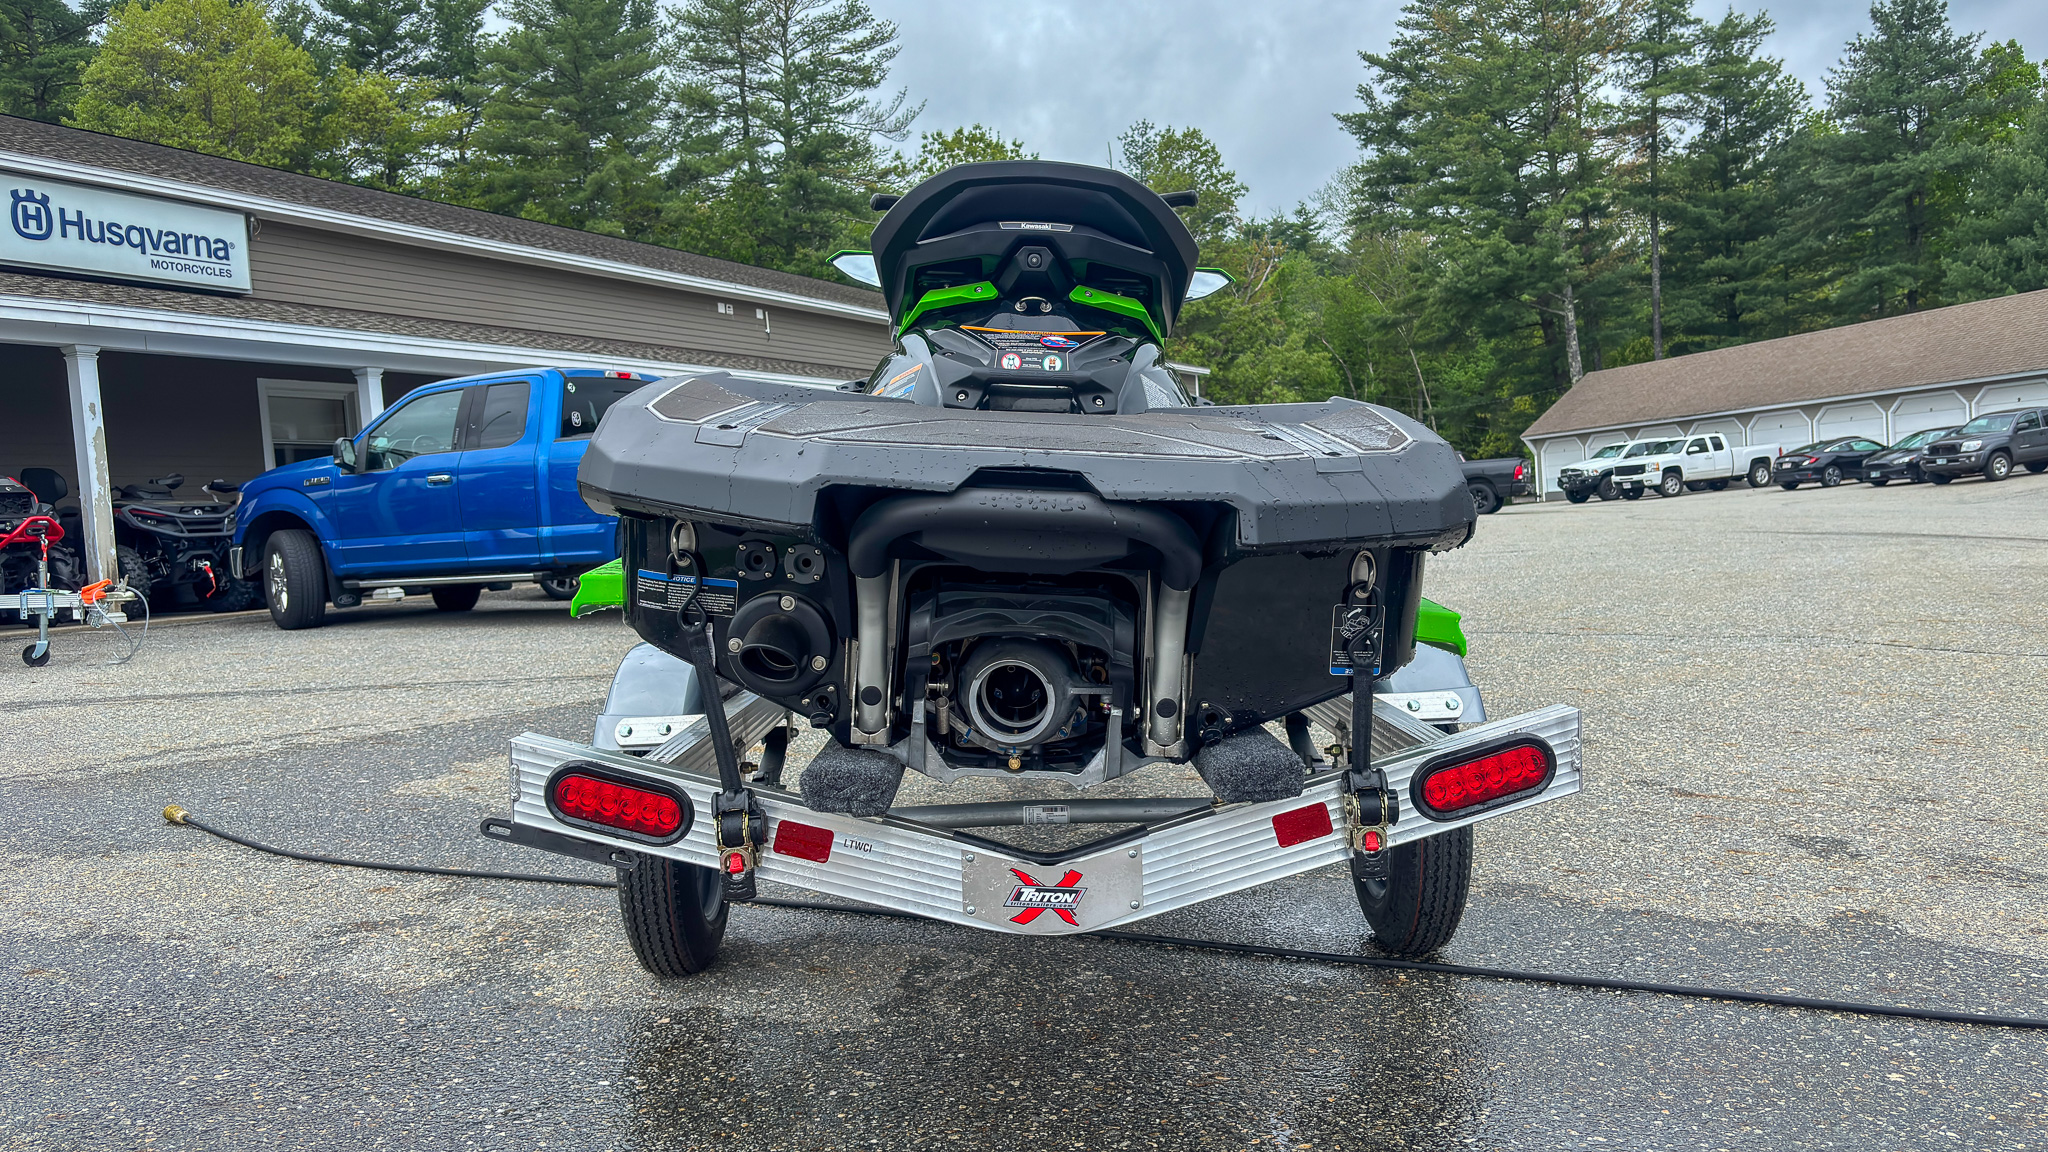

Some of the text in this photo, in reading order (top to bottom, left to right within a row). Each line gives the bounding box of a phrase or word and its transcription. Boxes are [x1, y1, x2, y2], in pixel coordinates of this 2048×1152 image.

[1021, 222, 1052, 231] Kawasaki
[150, 260, 233, 279] MOTORCYCLES
[843, 838, 873, 853] LTWCI
[1019, 888, 1077, 903] TRITON
